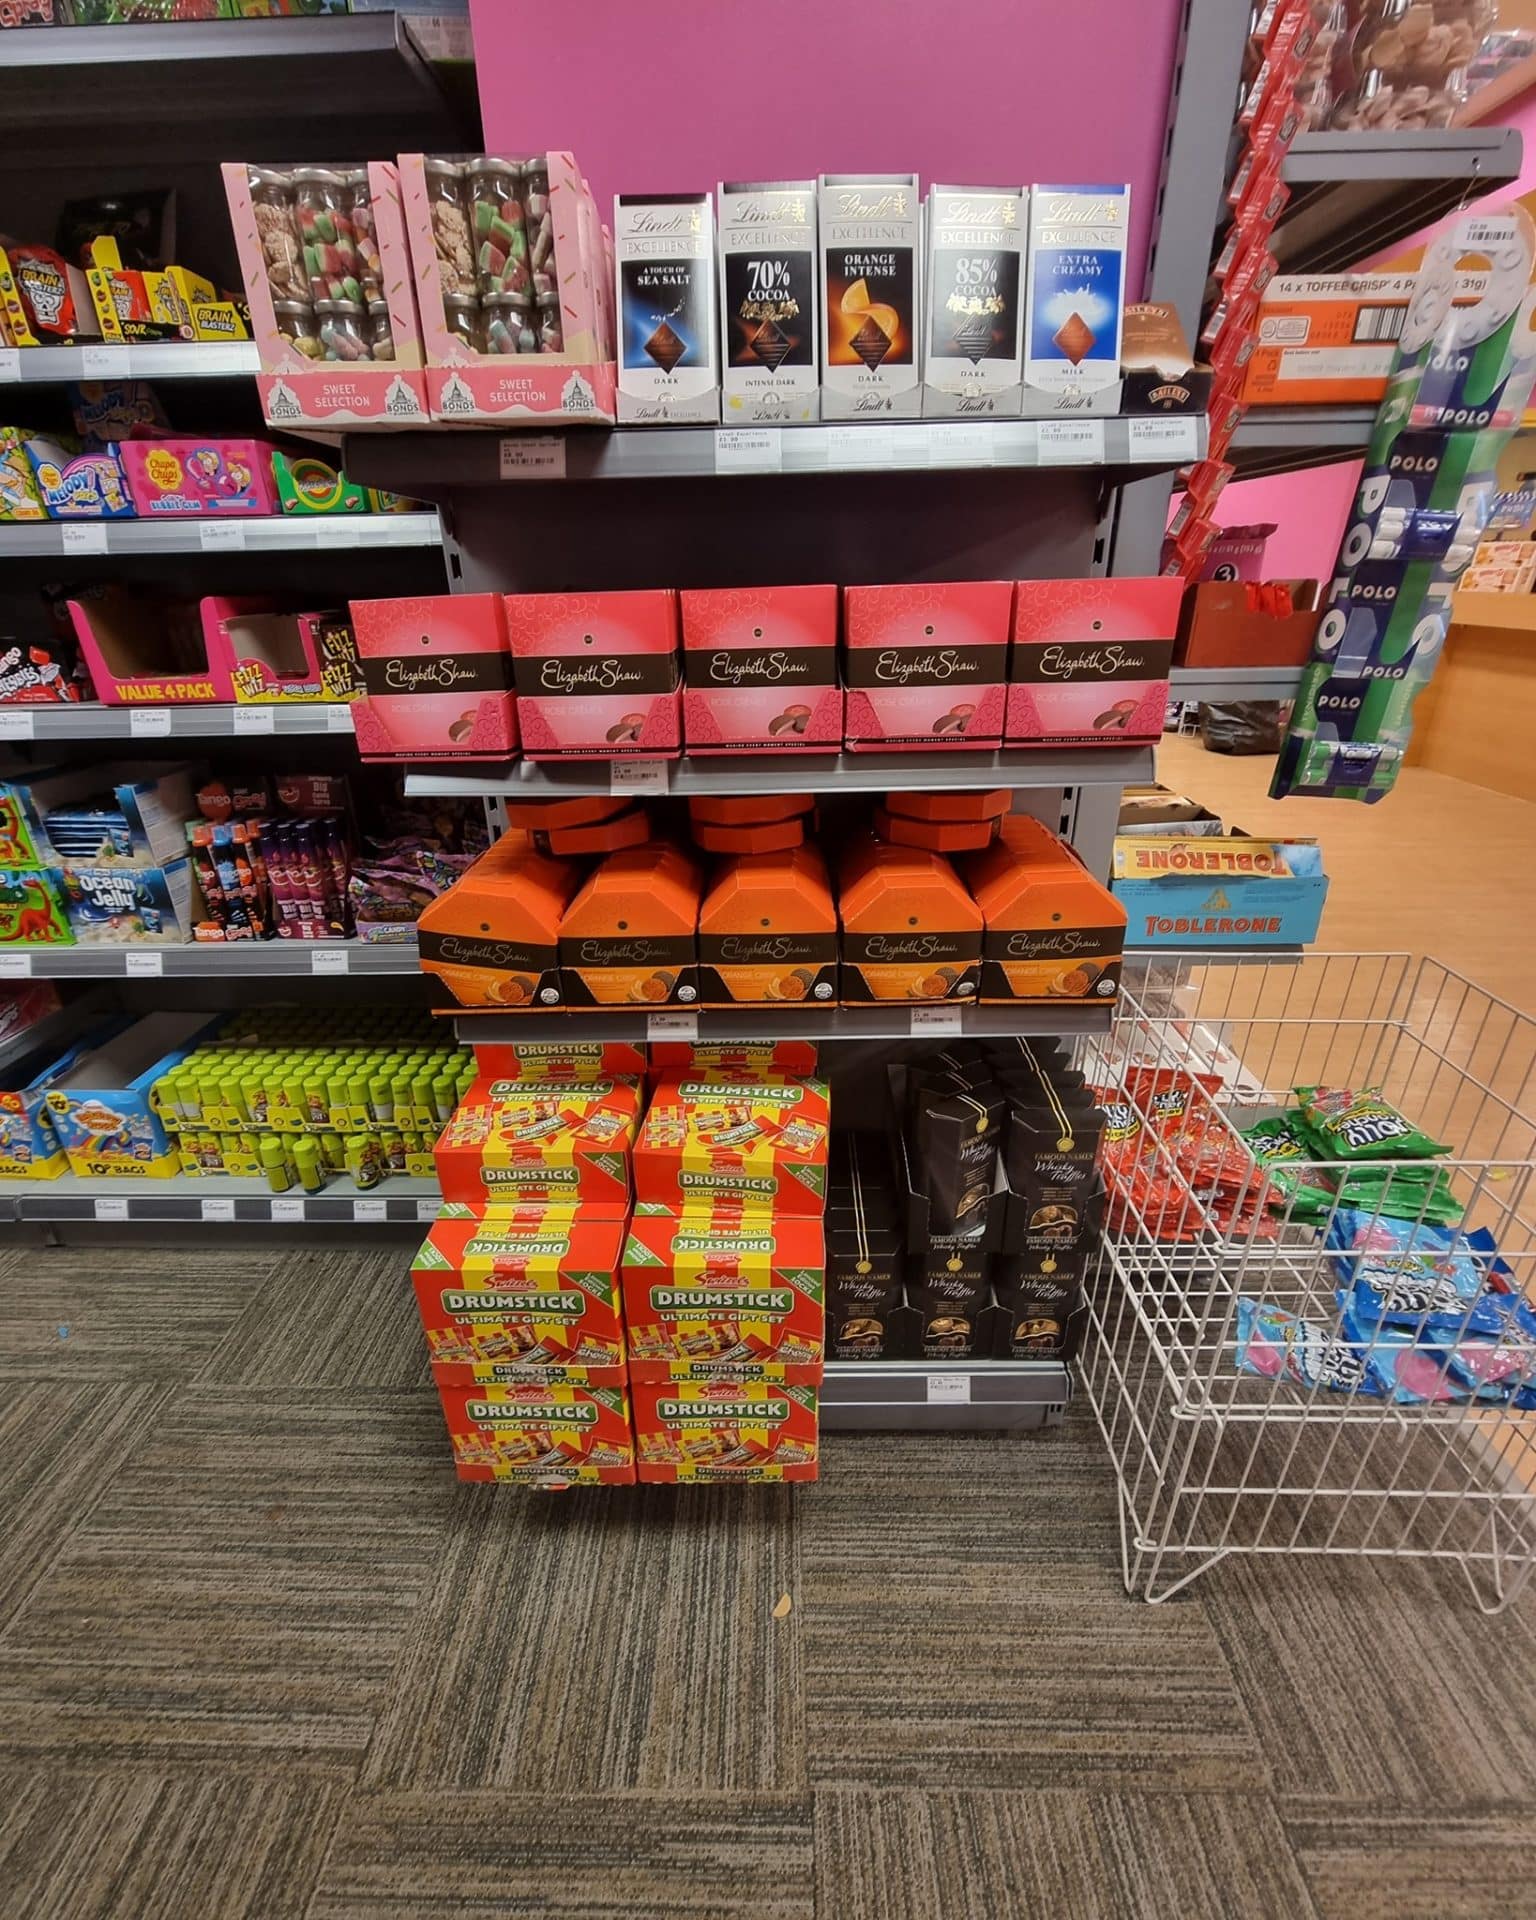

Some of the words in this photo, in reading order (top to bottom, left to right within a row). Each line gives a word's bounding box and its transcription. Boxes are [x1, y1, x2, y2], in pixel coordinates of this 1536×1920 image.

[943, 200, 1000, 224] Lindt
[1042, 200, 1100, 224] Lindt
[630, 212, 683, 234] Lindt
[1042, 230, 1116, 244] EXCELLENCE
[844, 254, 896, 265] ORANGE
[1058, 255, 1098, 265] EXTRA
[746, 260, 791, 290] 70%
[844, 266, 896, 276] INTENSE
[955, 257, 997, 284] 85%
[1052, 265, 1103, 275] CREAMY
[22, 268, 60, 287] BRAIN
[637, 276, 660, 286] SEA
[662, 275, 691, 285] SALT
[955, 286, 997, 297] COCOA
[1279, 282, 1291, 292] 14
[1306, 281, 1349, 292] TOFFEE
[1350, 280, 1388, 292] CRISP
[1393, 280, 1401, 290] 4
[1461, 278, 1487, 290] 31g)
[747, 290, 791, 301] COCOA
[199, 308, 232, 322] BRAIN
[124, 322, 146, 335] SOUR
[1062, 368, 1084, 376] MILK
[322, 384, 356, 394] SWEET
[499, 379, 533, 390] SWEET
[315, 396, 370, 408] SELECTION
[489, 391, 546, 402] SELECTION
[1054, 397, 1086, 409] Lindt
[270, 406, 302, 416] BONDS
[387, 403, 419, 413] BONDS
[443, 401, 475, 411] BONDS
[563, 399, 595, 409] BONDS
[853, 399, 884, 412] Lindt
[956, 398, 986, 412] Lindt
[634, 408, 661, 419] Lindt
[1443, 409, 1490, 424] POLO
[150, 460, 176, 470] Chupa
[1390, 455, 1439, 471] POLO
[151, 469, 178, 484] Chups
[47, 470, 89, 502] MELODY
[1351, 584, 1397, 600] POLO
[325, 629, 354, 654] FIZZ
[710, 653, 768, 684] Elizabeth
[766, 652, 809, 681] Shaw
[875, 651, 936, 683] Elizabeth
[931, 650, 979, 679] Shaw
[1039, 646, 1100, 679] Elizabeth
[1097, 645, 1145, 675] Shaw
[235, 663, 263, 685] FIZZ
[324, 662, 352, 684] FIZZ
[385, 659, 439, 691] Elizabeth
[436, 658, 478, 686] Shaw
[541, 660, 600, 692] Elizabeth
[597, 659, 643, 688] Shaw
[1362, 666, 1405, 679] POLO
[115, 683, 163, 700] VALUE
[165, 684, 176, 699] 4
[177, 683, 217, 699] PACK
[242, 679, 265, 697] WIZ
[330, 678, 354, 696] WIZ
[1318, 695, 1361, 709] POLO
[1136, 850, 1287, 875] TOBLERONE
[79, 875, 136, 891] Ocean
[92, 889, 137, 911] Jelly
[192, 926, 224, 939] Tango
[1145, 916, 1283, 936] TOBLERONE
[439, 937, 496, 963] Elizabeth
[492, 944, 531, 963] Shaw
[580, 939, 632, 965] Elizabeth
[630, 939, 671, 961] Shaw
[720, 937, 774, 961] Elizabeth
[771, 936, 812, 959] Shaw
[865, 936, 918, 960] Elizabeth
[916, 935, 959, 957] Shaw
[1007, 933, 1061, 958] Elizabeth
[1058, 932, 1101, 954] Shaw
[518, 1044, 598, 1056] DRUMSTICK
[496, 1082, 606, 1092] DRUMSTICK
[686, 1083, 796, 1098] DRUMSTICK
[493, 1095, 548, 1103] ULTIMATE
[683, 1097, 739, 1106] ULTIMATE
[743, 1098, 769, 1107] GIFT
[771, 1101, 794, 1109] SET
[713, 1123, 760, 1141] DRUMSTICK
[1349, 1120, 1409, 1147] JOLLY
[114, 1165, 146, 1174] BAGS
[486, 1169, 574, 1181] DRUMSTICK
[1034, 1161, 1074, 1175] Whisky
[683, 1176, 772, 1190] DRUMSTICK
[471, 1243, 564, 1253] DRUMSTICK
[678, 1239, 770, 1250] DRUMSTICK
[694, 1271, 750, 1288] Swizzels
[839, 1281, 874, 1292] Whisky
[928, 1278, 965, 1290] Whisky
[1021, 1280, 1057, 1291] Whisky
[449, 1296, 577, 1310] DRUMSTICK
[658, 1292, 786, 1308] DRUMSTICK
[455, 1316, 518, 1325] ULTIMATE
[522, 1316, 550, 1325] GIFT
[554, 1317, 579, 1326] SET
[661, 1313, 725, 1321] ULTIMATE
[729, 1313, 759, 1322] GIFT
[761, 1314, 785, 1324] SET
[473, 1405, 590, 1418] DRUMSTICK
[664, 1402, 782, 1416] DRUMSTICK
[478, 1423, 538, 1432] ULTIMATE
[540, 1423, 567, 1432] GIFT
[569, 1424, 593, 1432] SET
[666, 1421, 726, 1430] ULTIMATE
[729, 1421, 758, 1430] GIFT
[759, 1422, 781, 1430] SET
